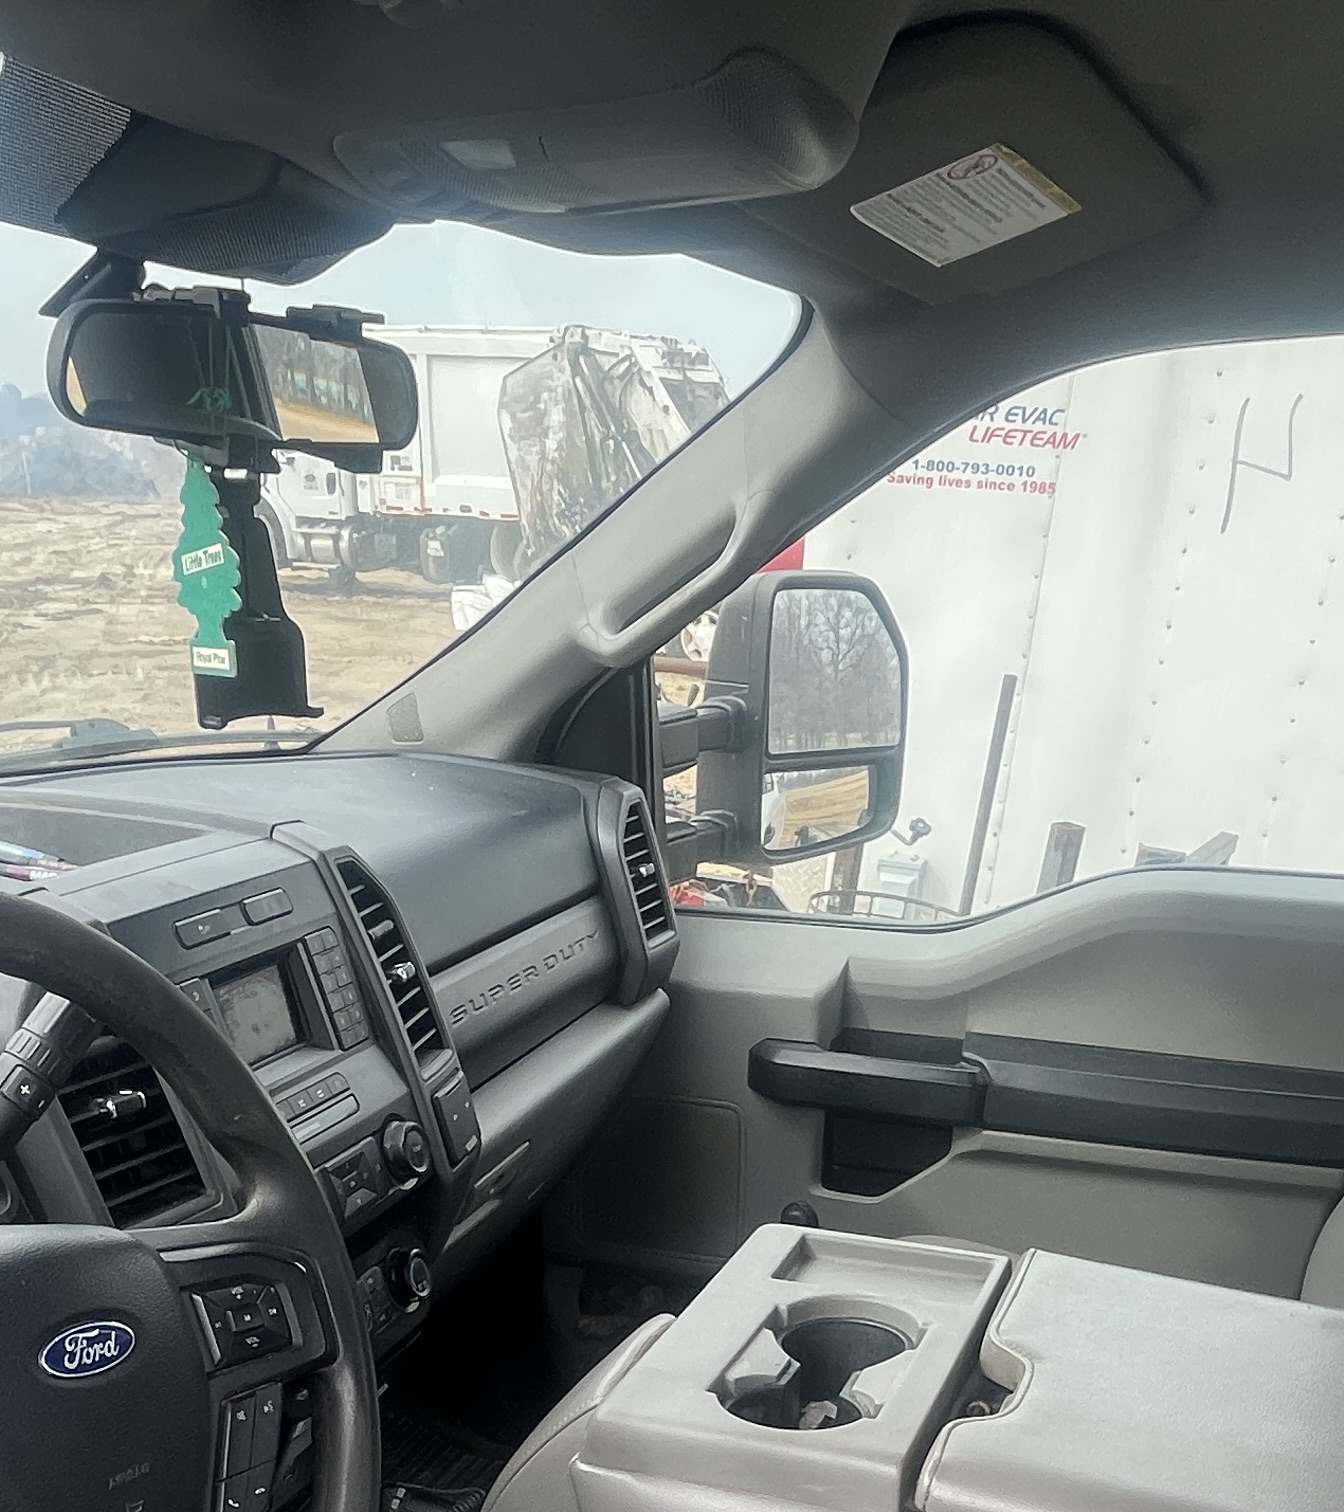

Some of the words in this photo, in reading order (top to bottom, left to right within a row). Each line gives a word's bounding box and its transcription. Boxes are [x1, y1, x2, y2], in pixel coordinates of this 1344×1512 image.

[1004, 405, 1065, 426] EVAC
[968, 424, 1081, 450] LIFETEAM
[911, 458, 1036, 478] 1-800-793-0010
[887, 471, 934, 489] Saving
[938, 475, 972, 489] lives
[976, 478, 1016, 492] since
[1020, 480, 1056, 495] 1985
[450, 965, 540, 1026] SUPER
[542, 929, 599, 972] DUTY
[64, 1328, 120, 1371] Ford
